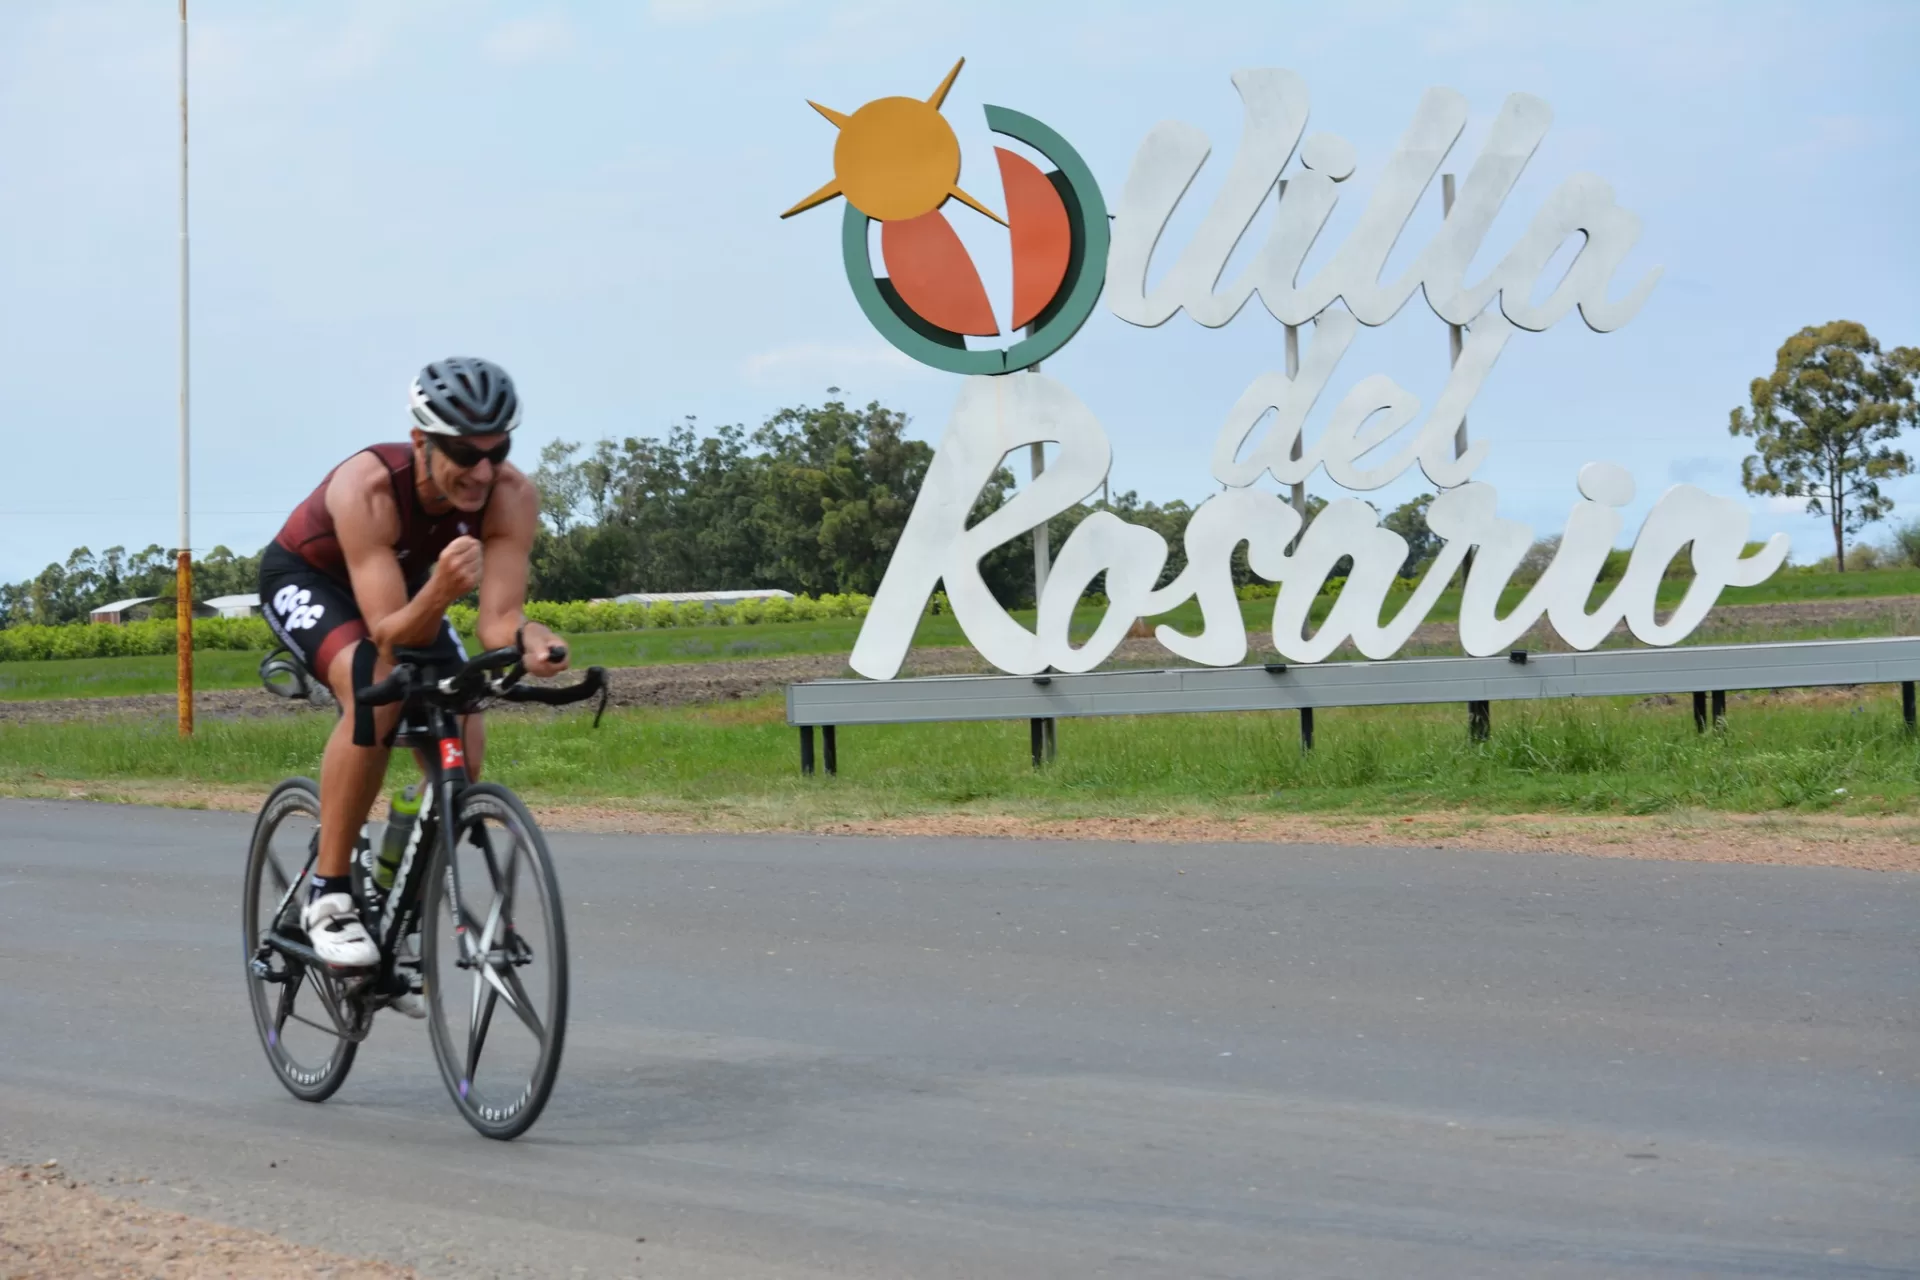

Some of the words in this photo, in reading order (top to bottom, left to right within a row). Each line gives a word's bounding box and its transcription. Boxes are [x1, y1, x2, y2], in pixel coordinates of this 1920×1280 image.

[1106, 67, 1665, 333] Villa
[848, 372, 1789, 681] Rosario
[1211, 308, 1512, 491] del
